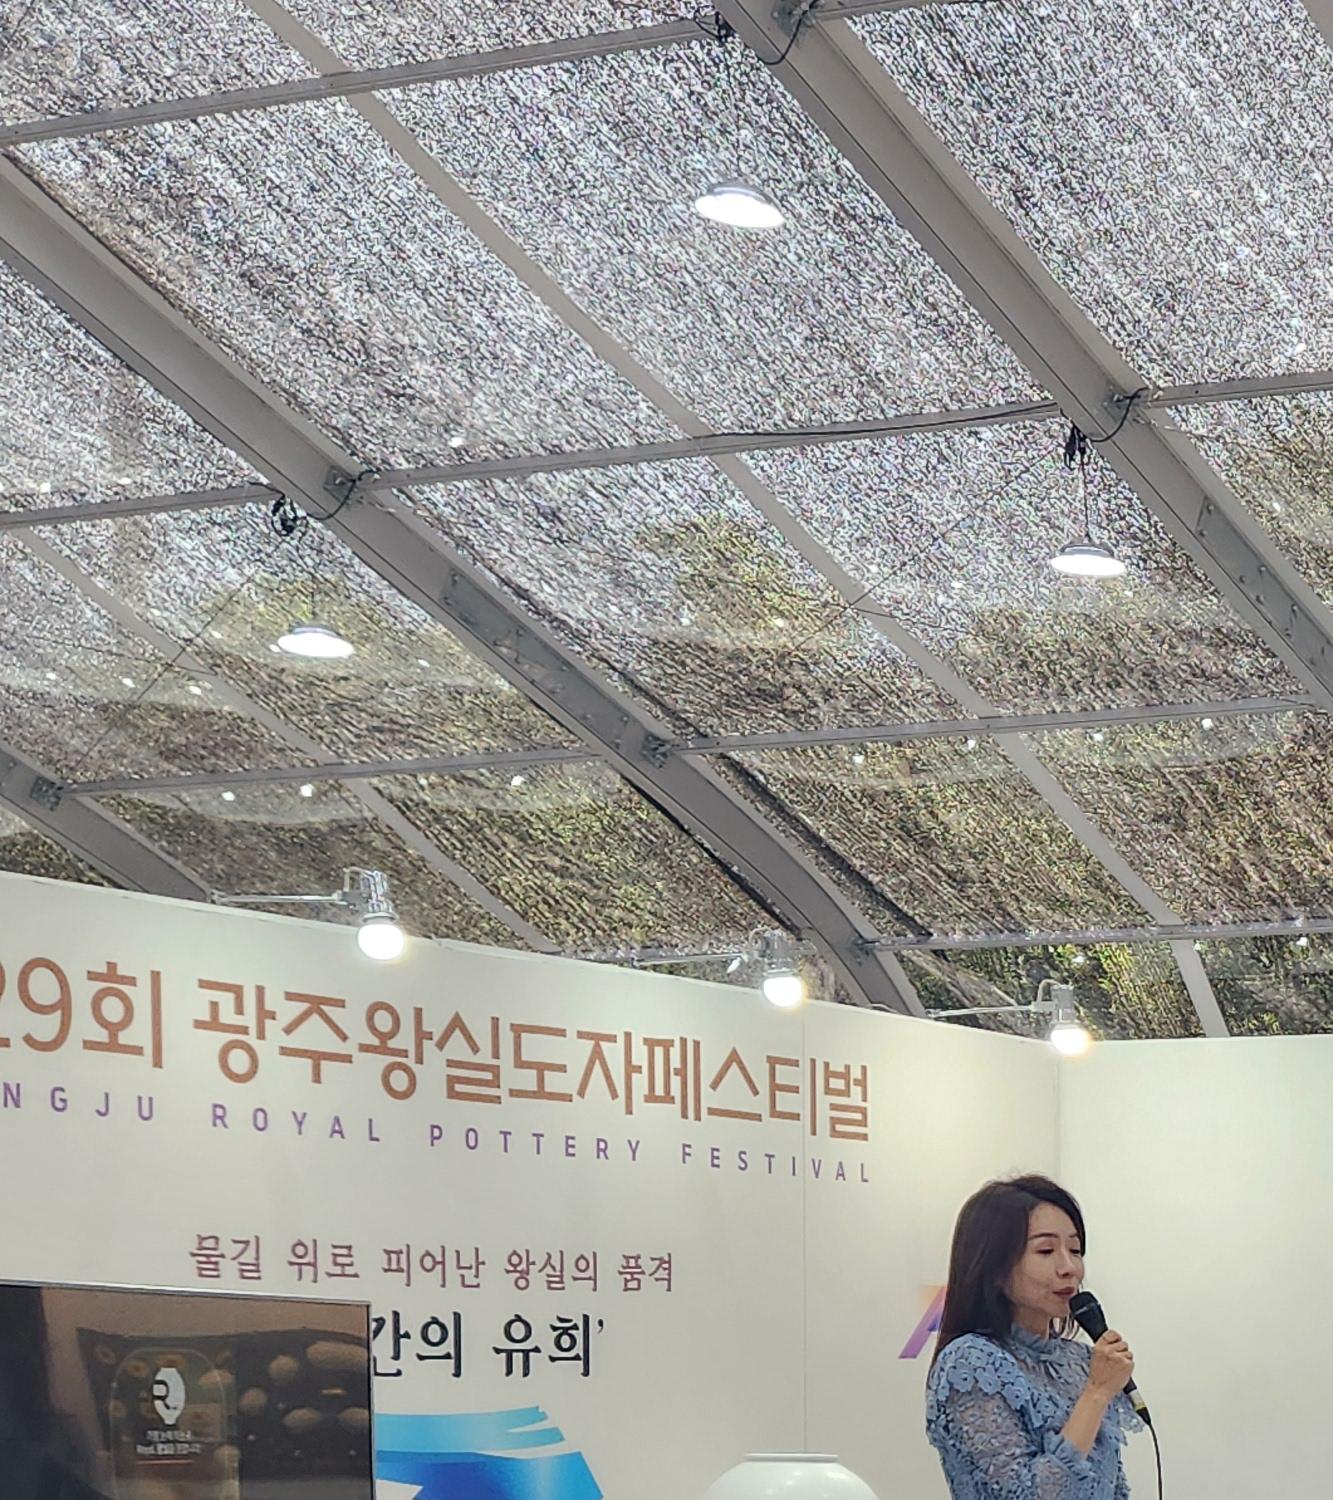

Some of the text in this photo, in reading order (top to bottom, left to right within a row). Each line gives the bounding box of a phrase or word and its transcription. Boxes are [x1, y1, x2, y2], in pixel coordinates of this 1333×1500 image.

[0, 957, 869, 1142] 9회 광주왕실도자페스티벌
[211, 1103, 380, 1142] ROYAL
[429, 1124, 641, 1162] POTTERY
[681, 1143, 869, 1183] FESTIVAL
[189, 1233, 675, 1293] 물길 위로 피어난 왕실의 품격
